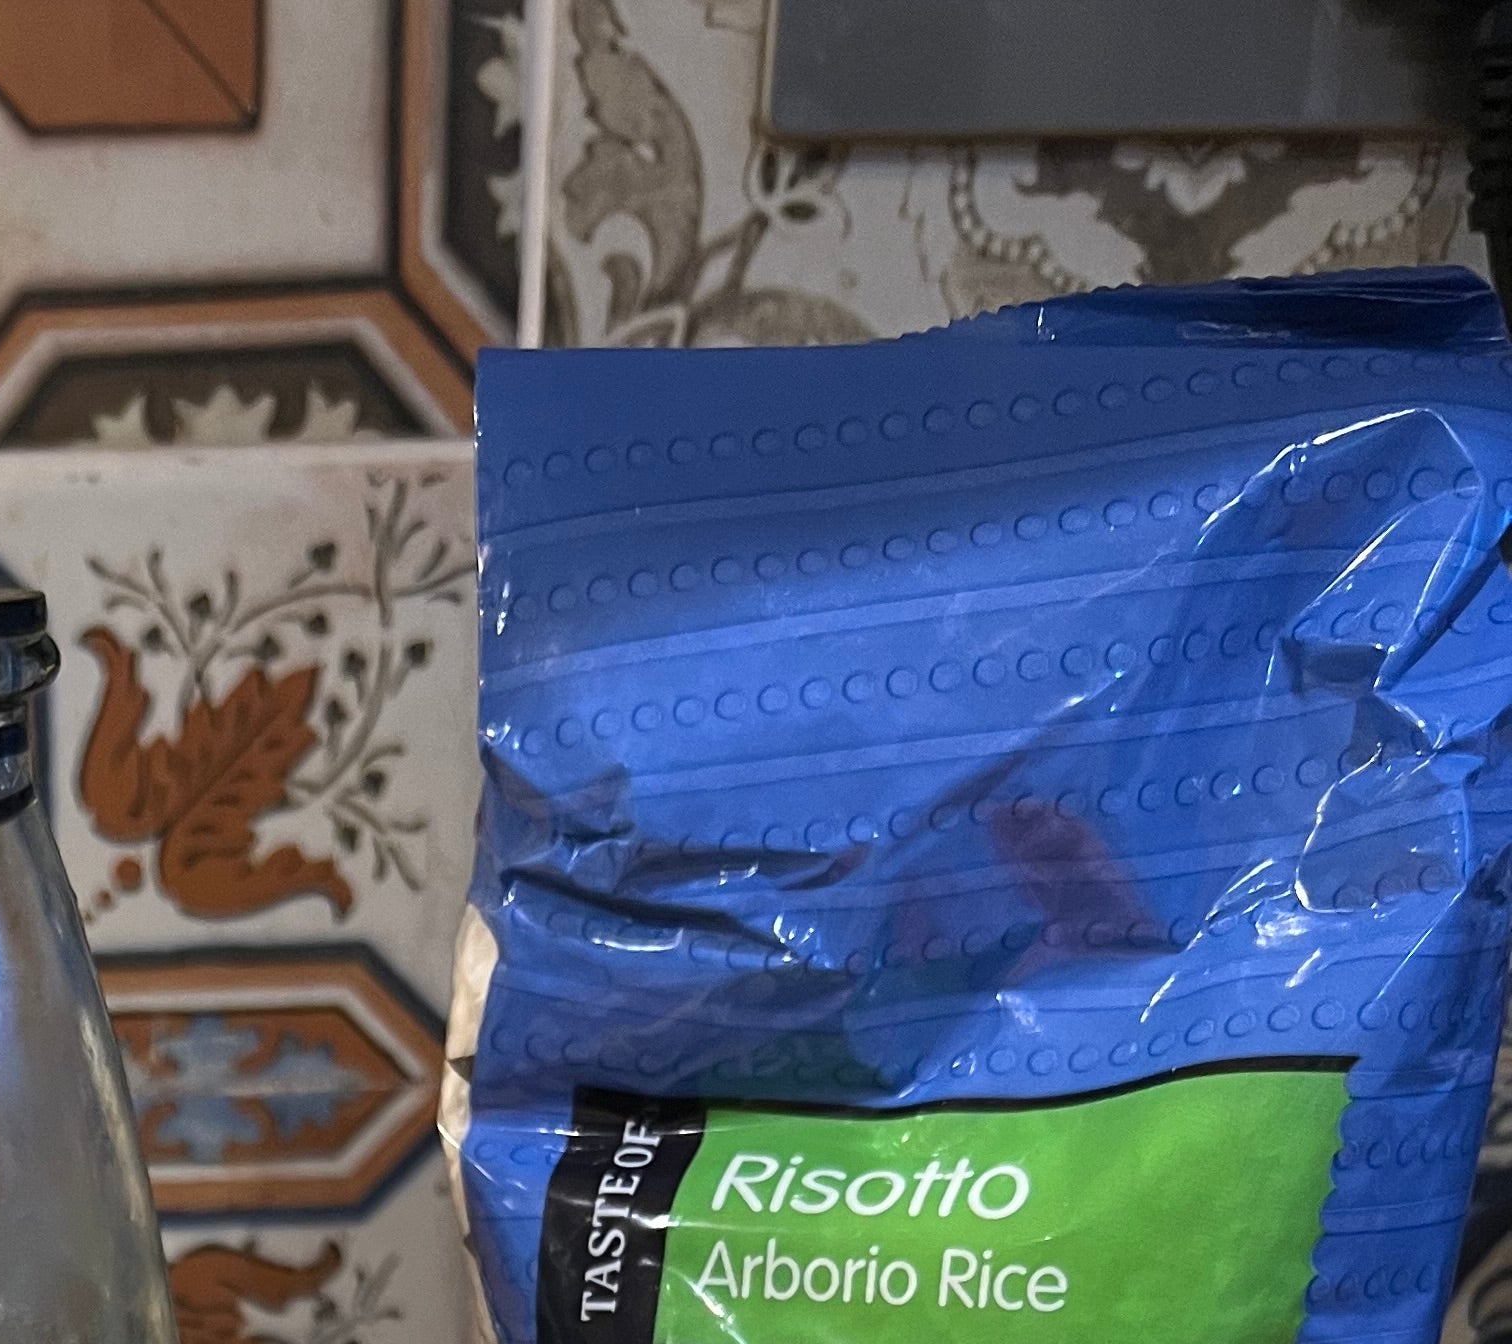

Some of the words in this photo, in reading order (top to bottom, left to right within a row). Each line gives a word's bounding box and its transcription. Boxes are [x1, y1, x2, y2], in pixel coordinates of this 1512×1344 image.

[581, 1169, 640, 1321] TASTE
[613, 1118, 663, 1171] OF
[710, 1152, 1030, 1221] Risotto
[696, 1238, 919, 1306] Arborio
[939, 1247, 1069, 1313] Rice
